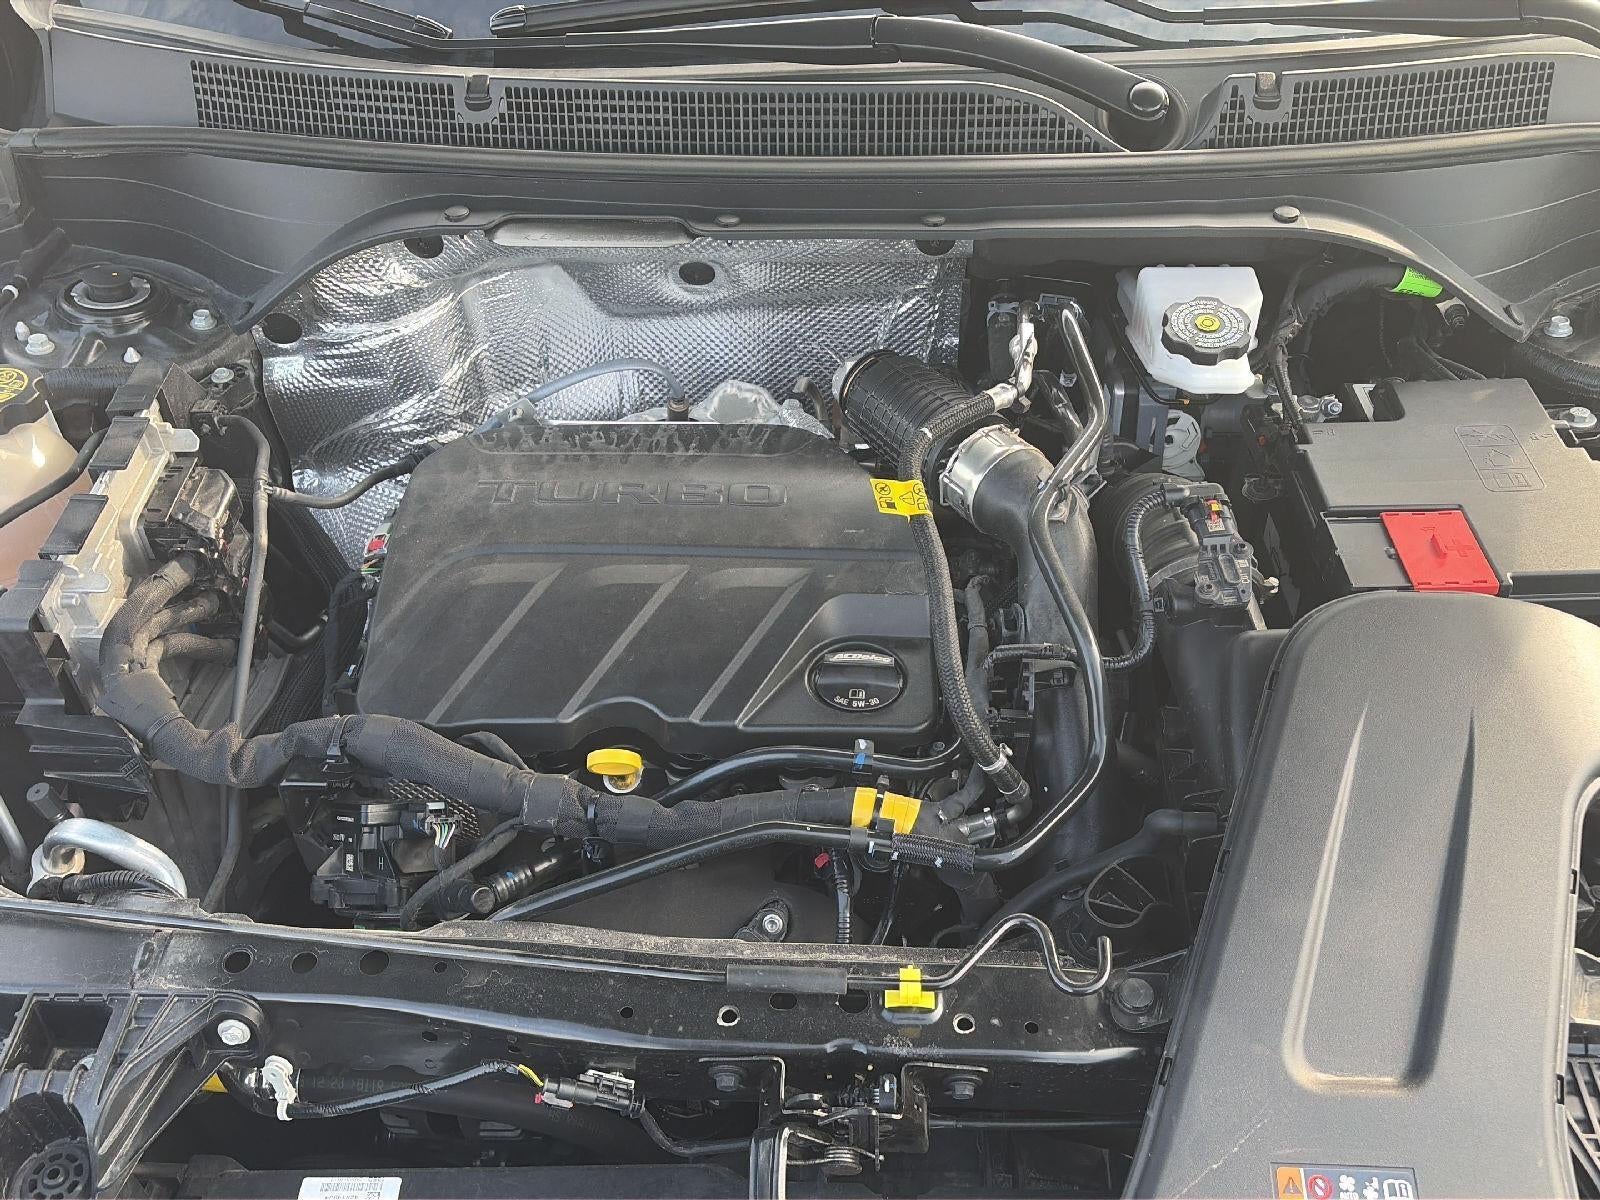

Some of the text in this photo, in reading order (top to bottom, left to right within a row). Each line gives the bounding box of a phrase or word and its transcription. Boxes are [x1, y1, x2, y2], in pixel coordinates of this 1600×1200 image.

[478, 479, 788, 507] TURBO
[829, 653, 892, 663] ACDelco
[834, 696, 879, 707] SAE 5W-30
